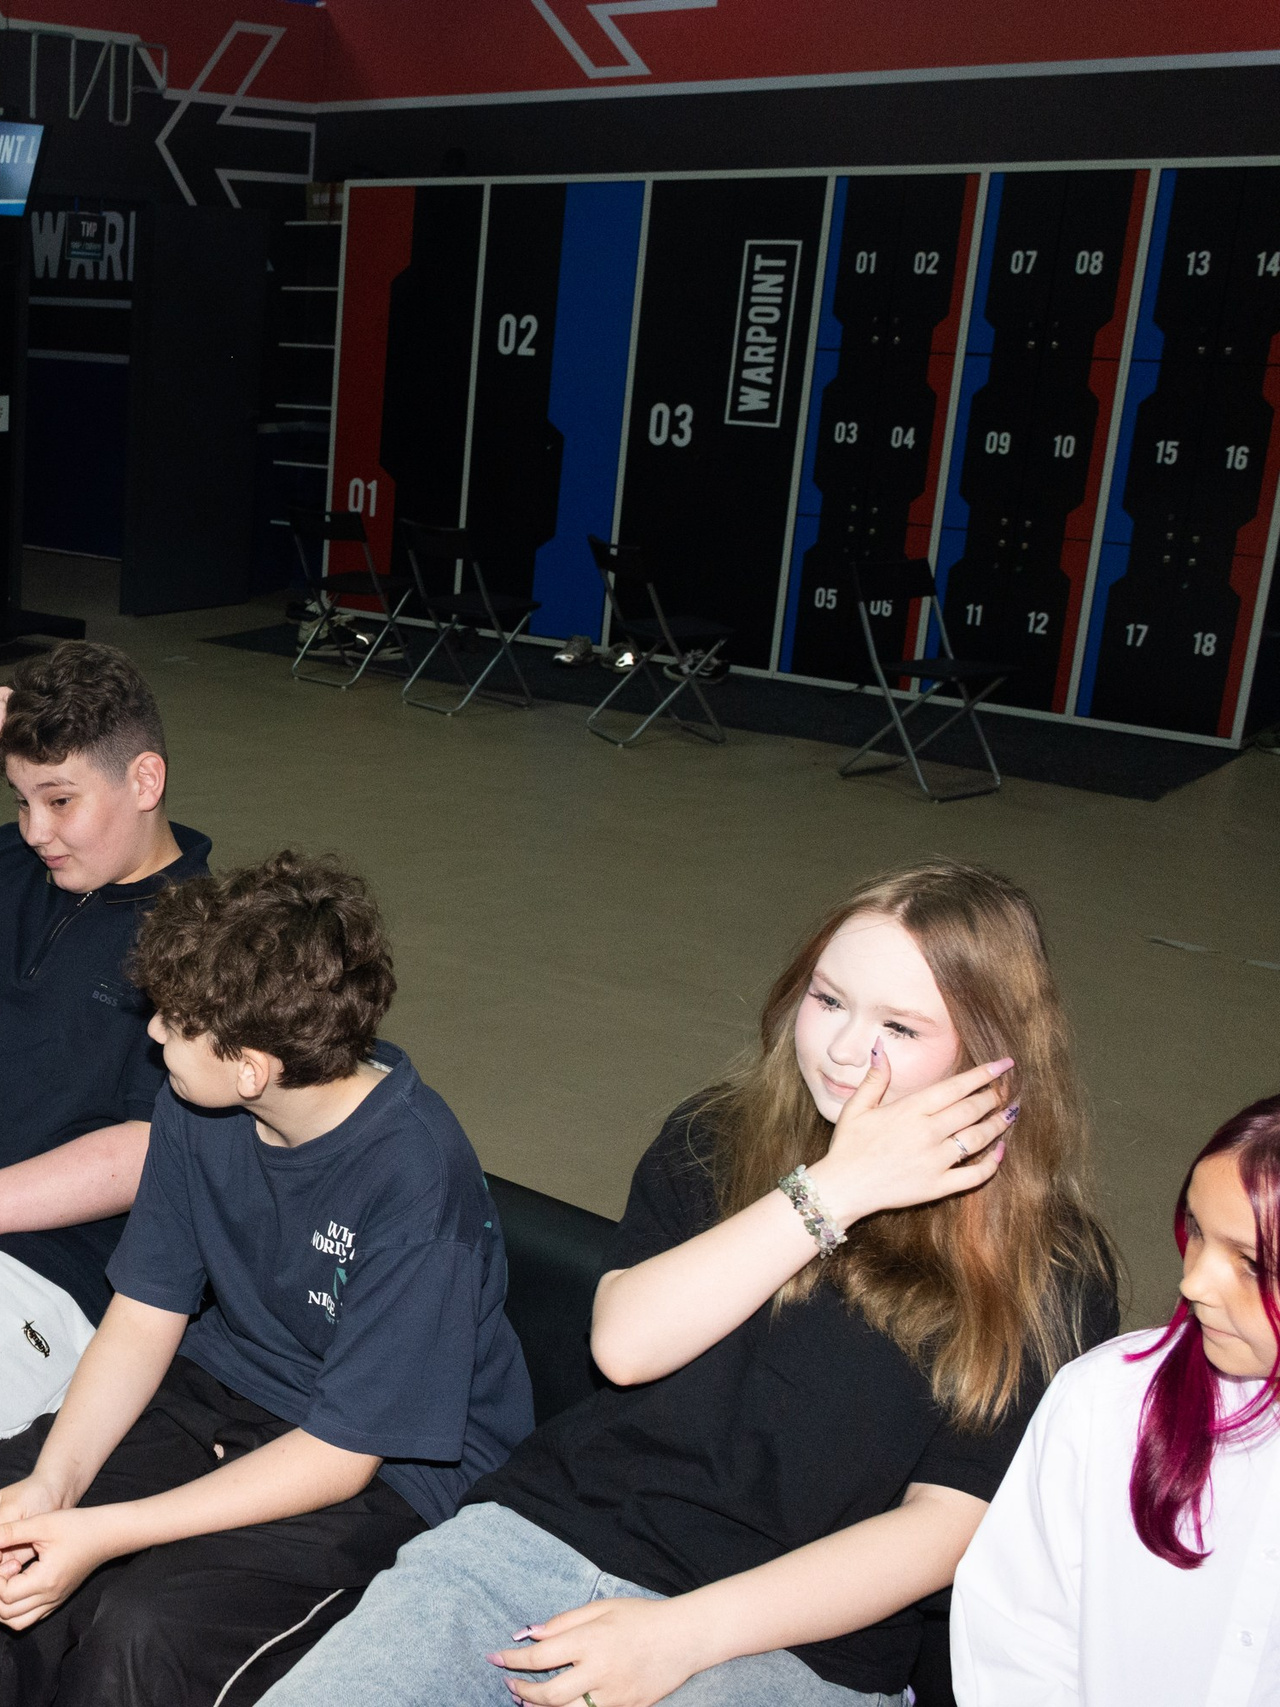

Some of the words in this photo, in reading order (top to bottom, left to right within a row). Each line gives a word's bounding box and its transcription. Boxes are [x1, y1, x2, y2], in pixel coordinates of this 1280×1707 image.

[856, 251, 876, 273] 01
[914, 252, 939, 274] 02
[1011, 251, 1037, 273] 07
[1076, 251, 1103, 274] 08
[1188, 251, 1210, 275] 13
[1258, 252, 1280, 276] 14
[498, 314, 537, 355] 02
[738, 254, 787, 413] WARPOINT
[649, 403, 693, 446] 03
[835, 422, 857, 443] 03
[891, 427, 914, 448] 04
[986, 432, 1010, 454] 09
[1055, 435, 1075, 458] 10
[1157, 441, 1179, 464] 15
[1227, 446, 1249, 469] 16
[348, 478, 377, 516] 01
[815, 588, 837, 609] 05
[967, 604, 982, 625] 11
[1028, 612, 1048, 634] 12
[1127, 624, 1148, 646] 17
[1195, 632, 1216, 656] 18
[91, 990, 118, 1007] BOSS
